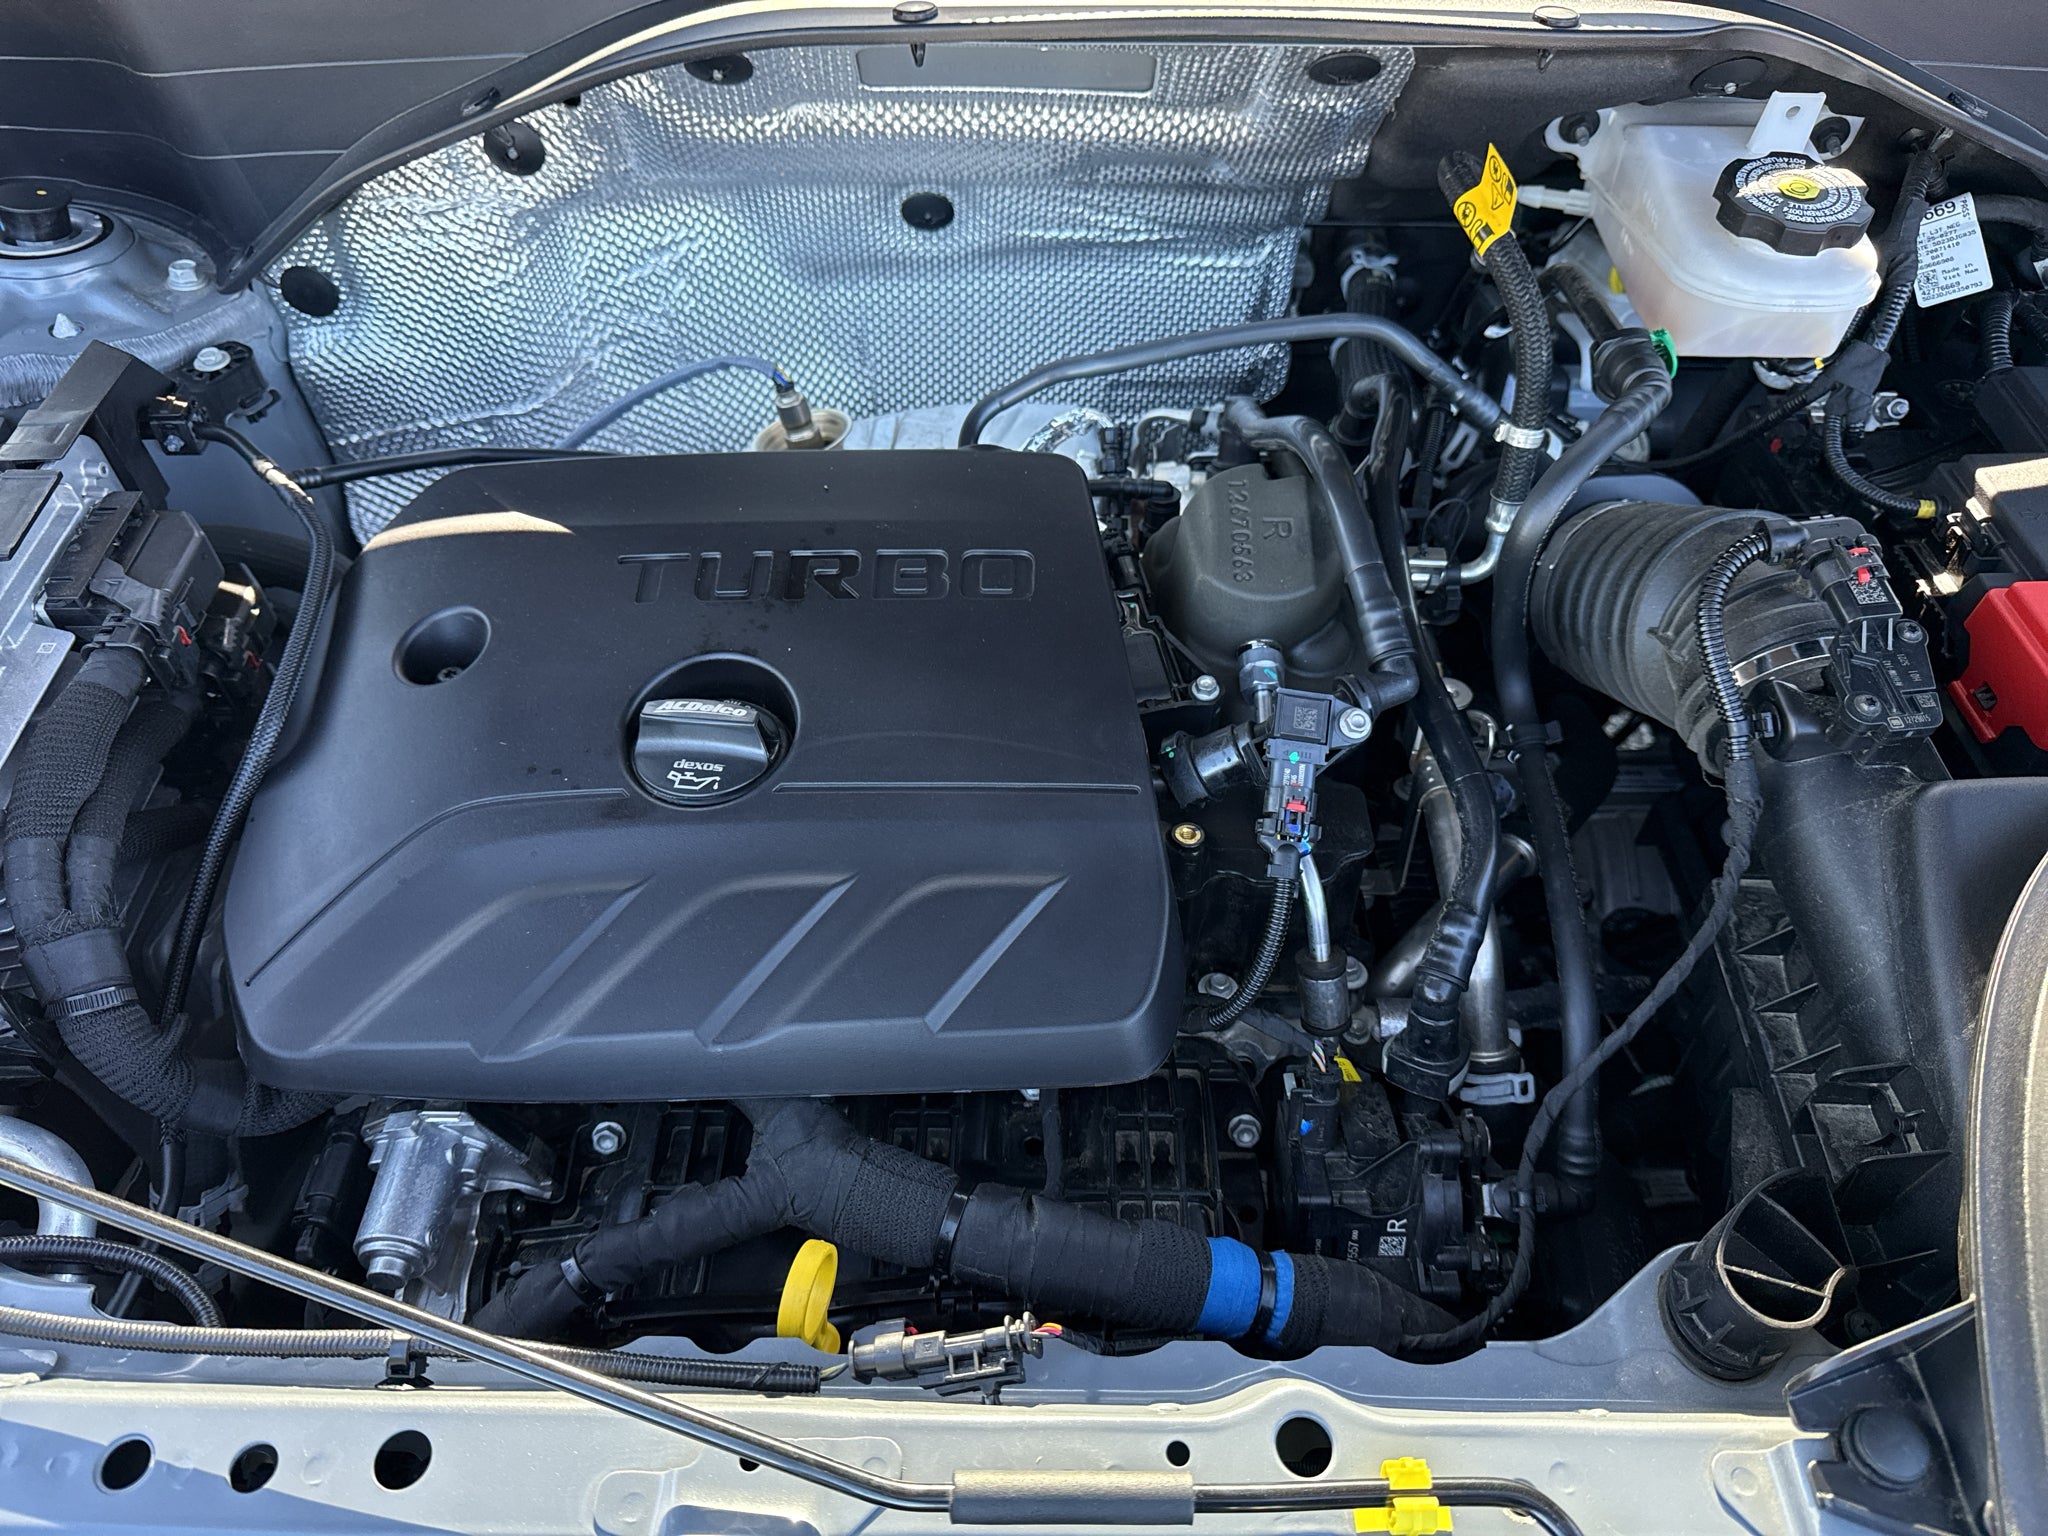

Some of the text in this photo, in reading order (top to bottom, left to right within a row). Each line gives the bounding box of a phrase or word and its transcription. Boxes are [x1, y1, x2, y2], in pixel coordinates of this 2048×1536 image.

[1941, 266, 1960, 275] Made
[1943, 272, 1961, 281] Viet
[1262, 516, 1294, 540] R
[617, 548, 1036, 605] TURBO
[654, 700, 748, 717] ACDelco
[673, 758, 726, 772] dexos
[1387, 1218, 1407, 1232] R
